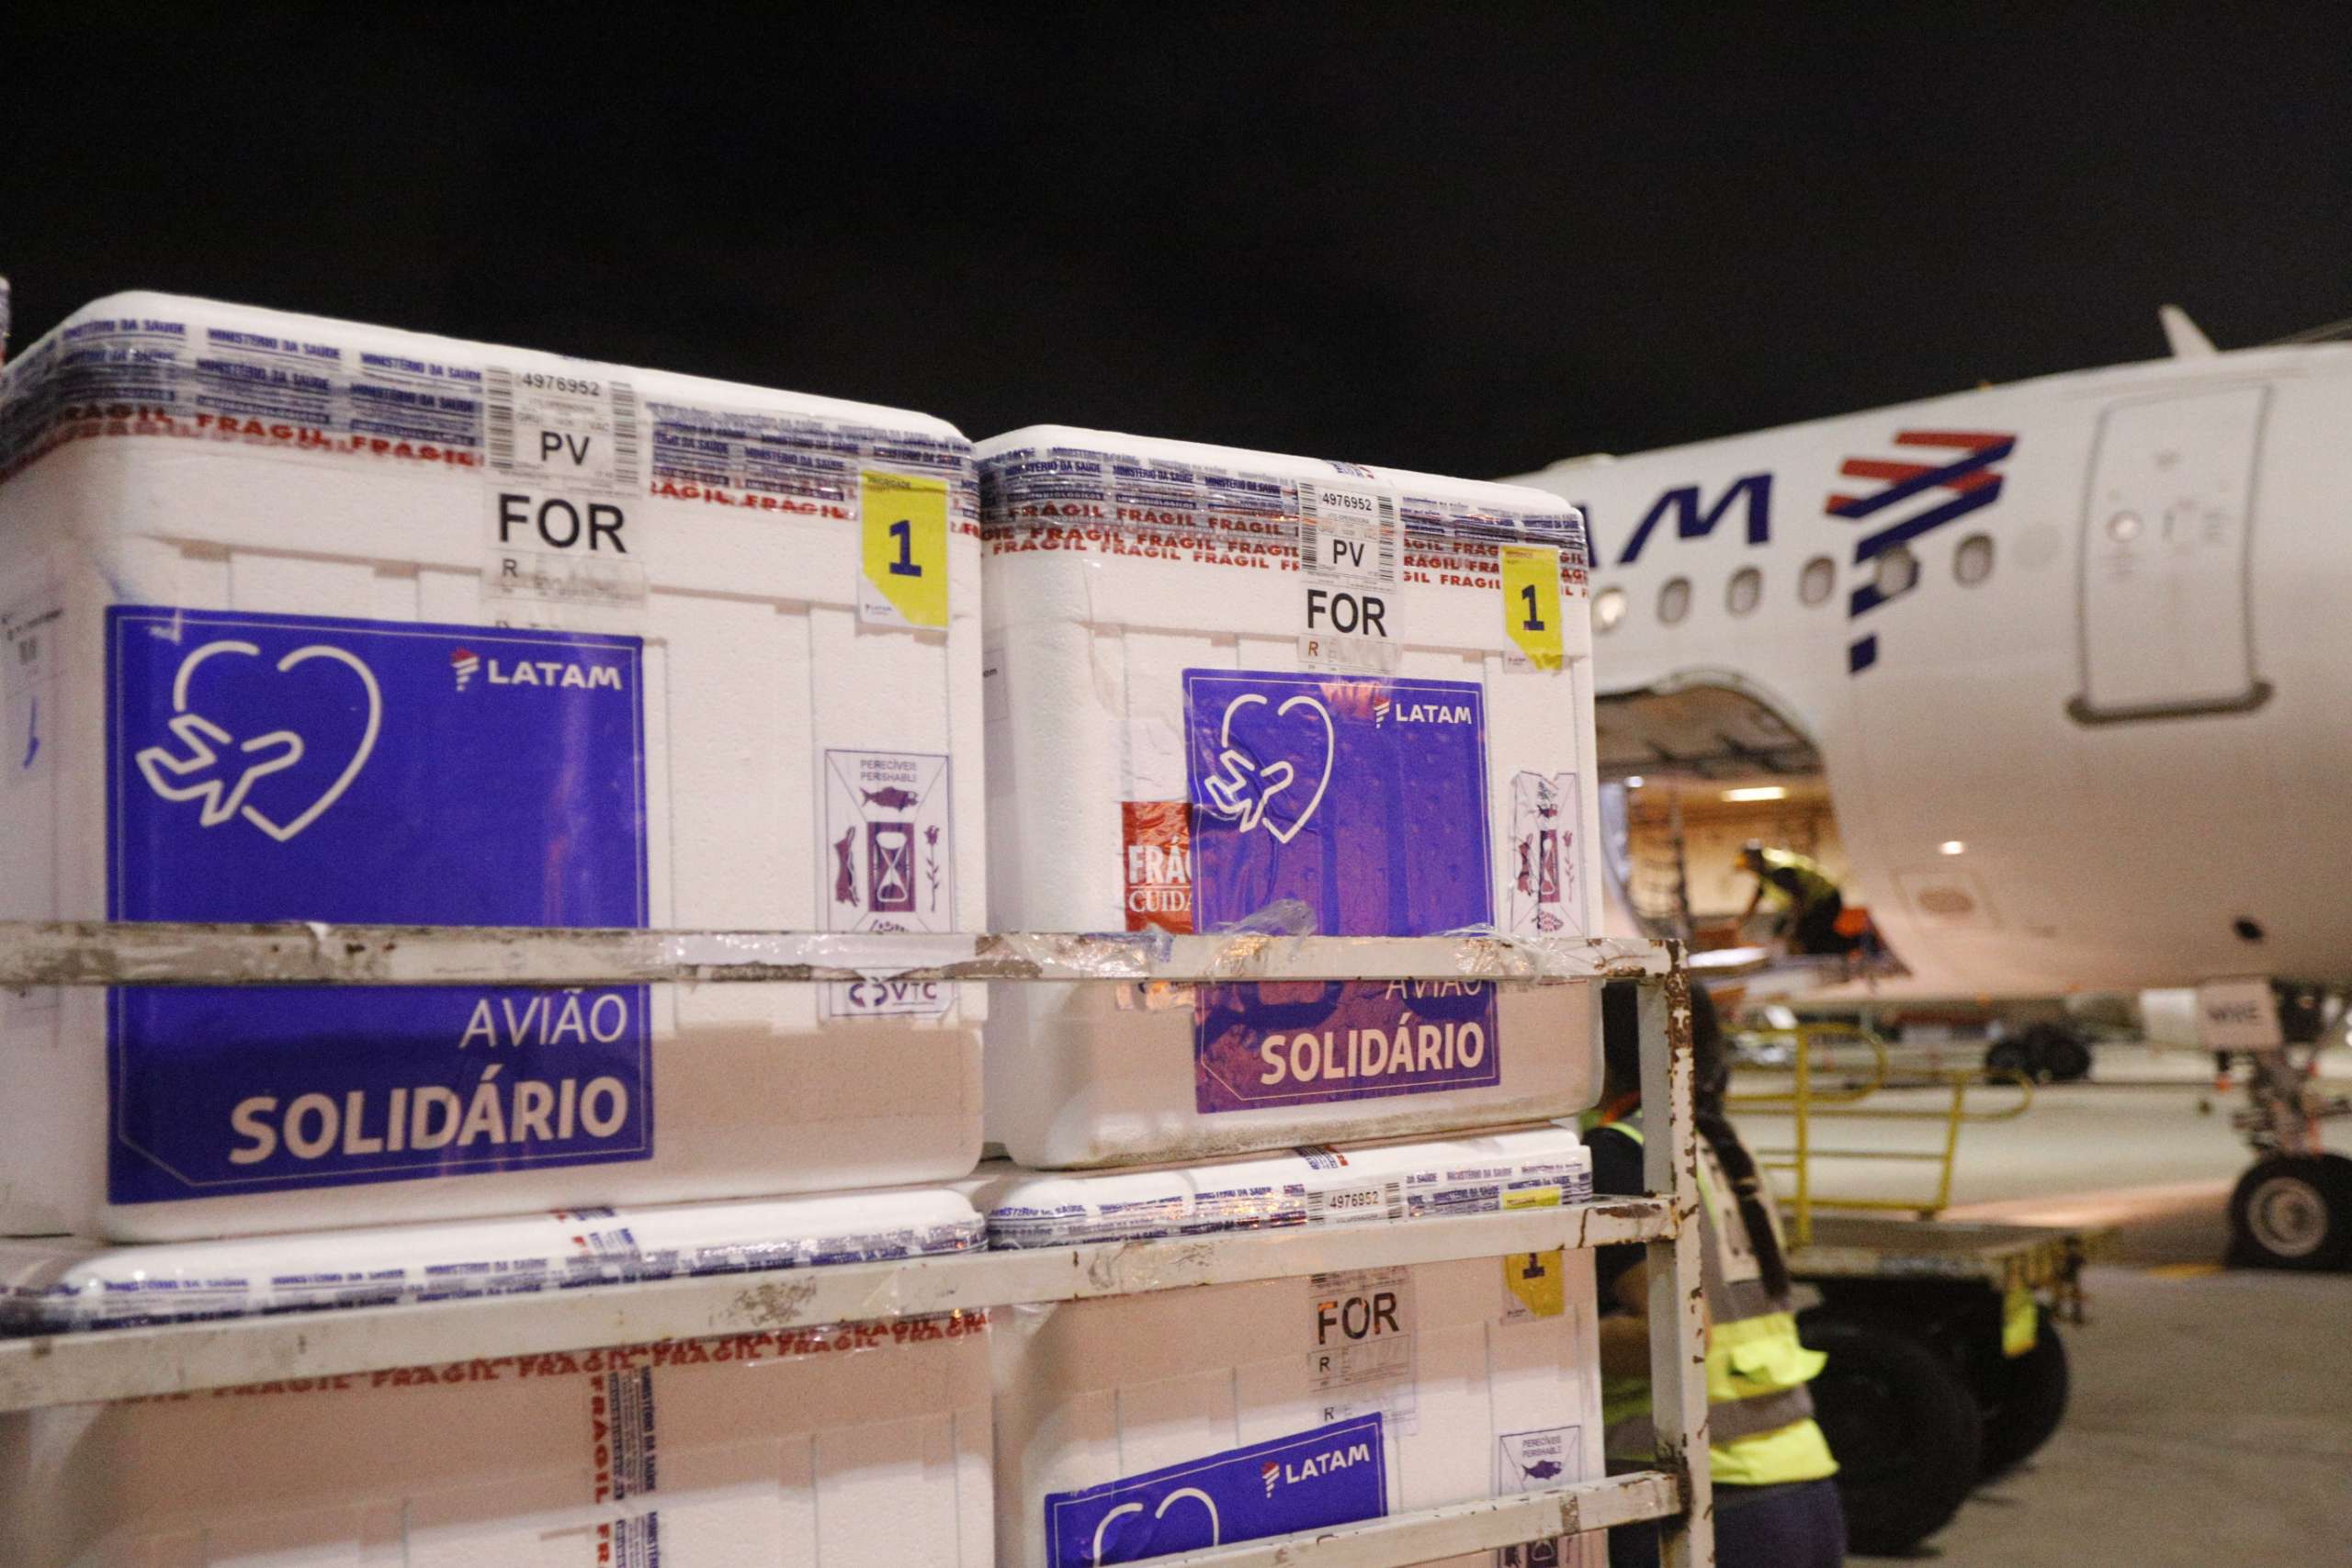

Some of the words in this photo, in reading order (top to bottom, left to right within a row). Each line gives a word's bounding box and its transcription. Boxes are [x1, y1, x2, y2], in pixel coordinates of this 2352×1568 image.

[522, 371, 600, 397] 4976952
[541, 431, 590, 466] PV
[1323, 492, 1372, 512] 4976952
[499, 492, 628, 554] FOR
[889, 519, 922, 578] 1
[1333, 538, 1364, 568] PV
[503, 558, 518, 578] R
[1307, 589, 1387, 637] FOR
[1521, 584, 1545, 631] 1
[1307, 641, 1319, 657] R
[488, 659, 623, 691] LATAM
[1396, 704, 1472, 725] LATAM
[459, 987, 629, 1049] AVIÃO
[1260, 1011, 1486, 1086] SOLIDÁRIO
[228, 1063, 628, 1166] SOLIDÁRIO
[1329, 1191, 1378, 1210] 4976952
[1317, 1292, 1400, 1346] FOR
[1319, 1357, 1330, 1372] R
[1286, 1443, 1371, 1484] LATAM
